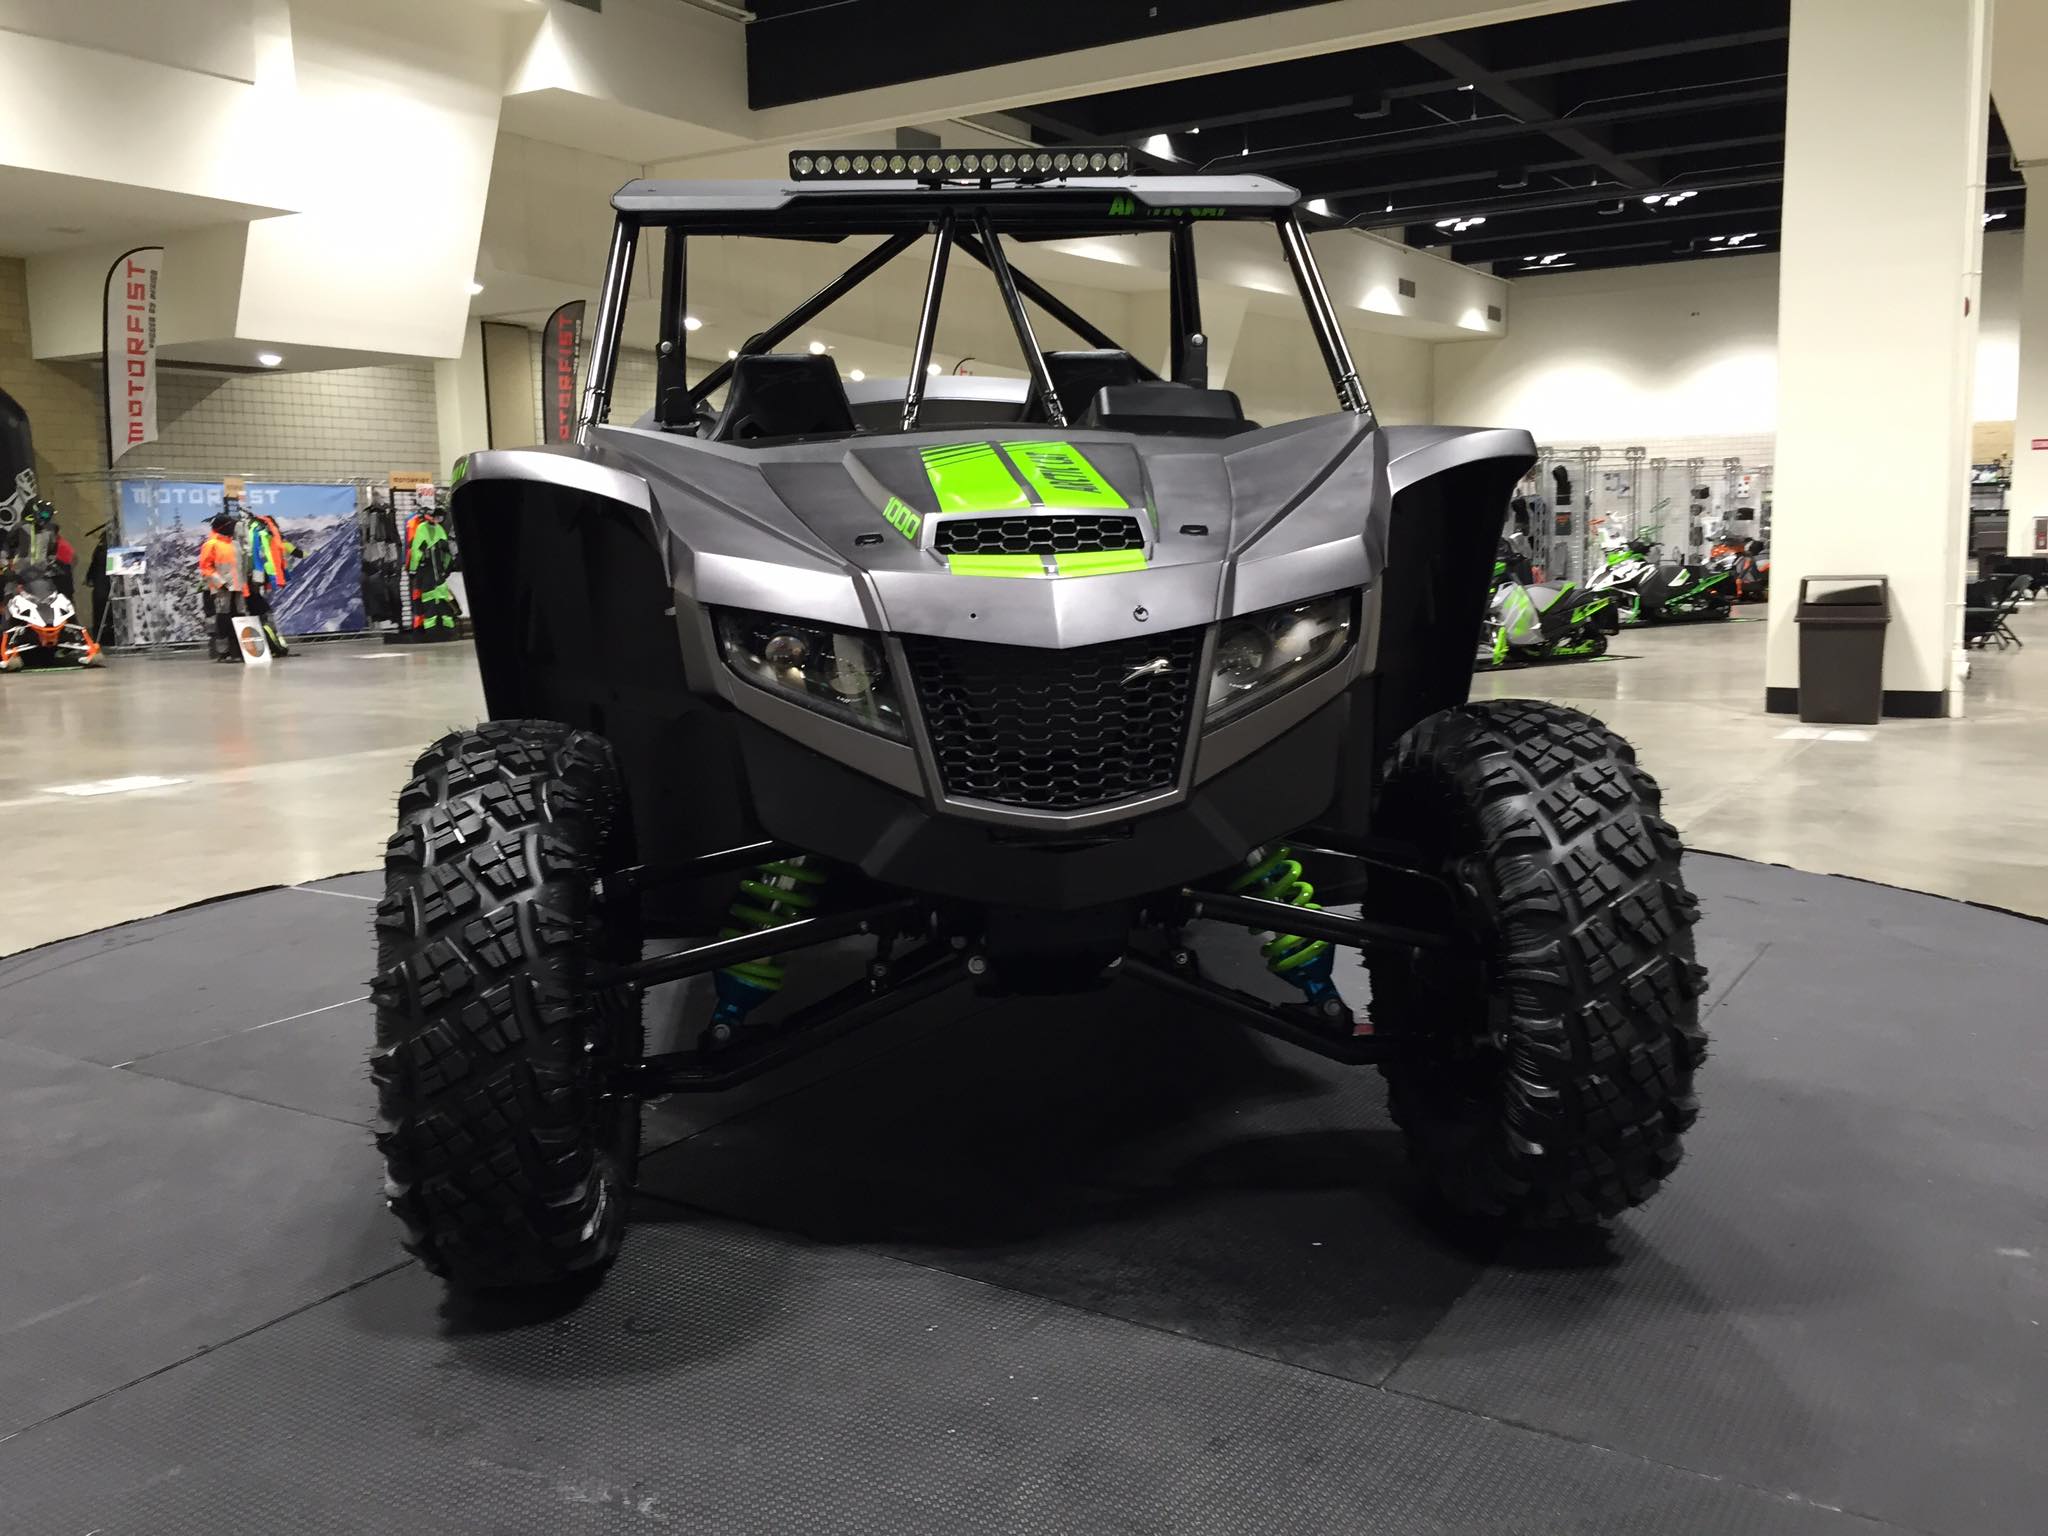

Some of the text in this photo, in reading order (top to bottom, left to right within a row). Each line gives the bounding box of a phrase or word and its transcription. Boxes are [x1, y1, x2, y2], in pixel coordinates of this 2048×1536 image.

[127, 258, 146, 445] MOTORFIST
[559, 313, 574, 440] OTORFIST
[1025, 451, 1102, 494] ARCTIC CAT
[131, 487, 281, 506] MOTORST
[882, 496, 921, 540] 1000
